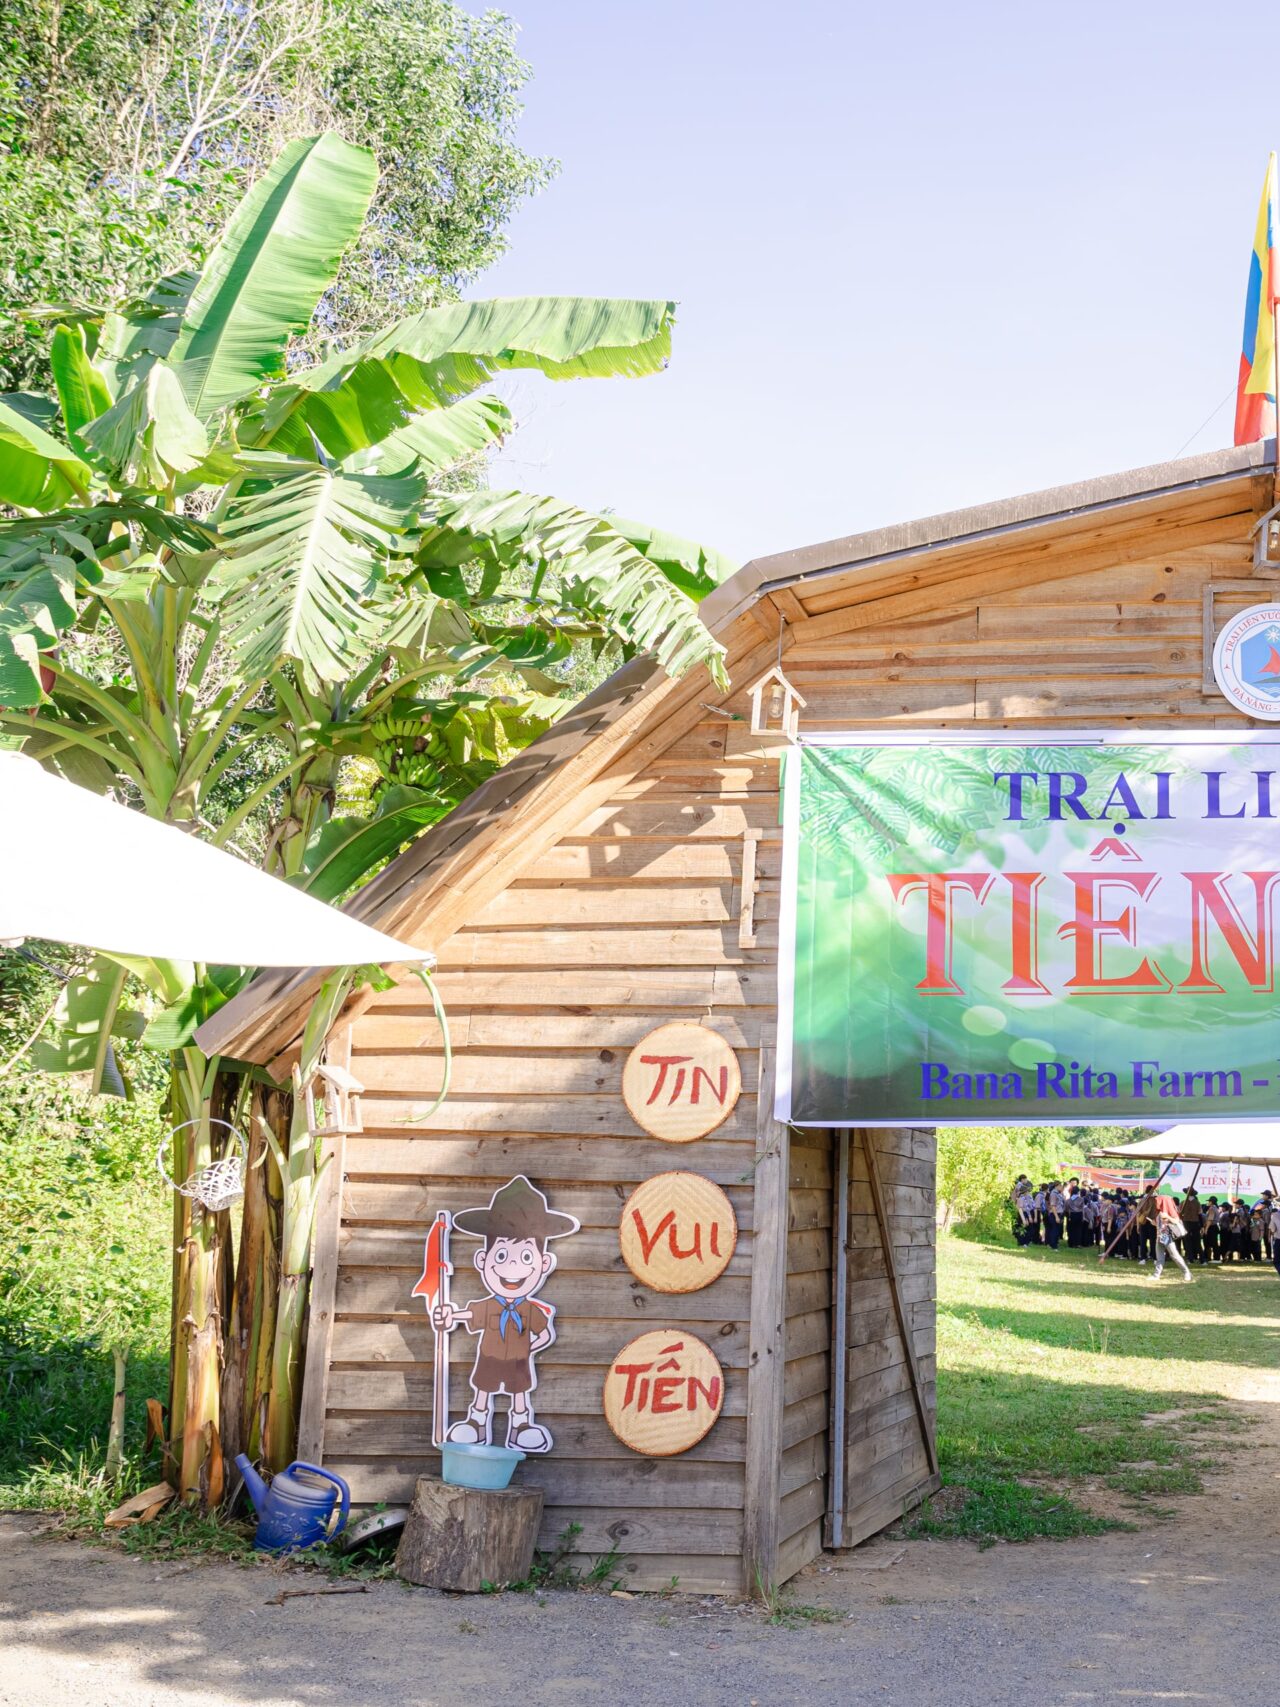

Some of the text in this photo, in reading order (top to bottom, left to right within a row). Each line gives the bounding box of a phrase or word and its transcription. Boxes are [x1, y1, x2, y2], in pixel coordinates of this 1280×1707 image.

[993, 771, 1177, 835] TRẠI
[640, 1055, 728, 1106] TIN
[919, 1062, 1023, 1100] Bana
[1033, 1060, 1120, 1099] Rita
[1129, 1060, 1244, 1098] Farm
[632, 1208, 721, 1266] VUI
[615, 1341, 720, 1414] TIẾN
